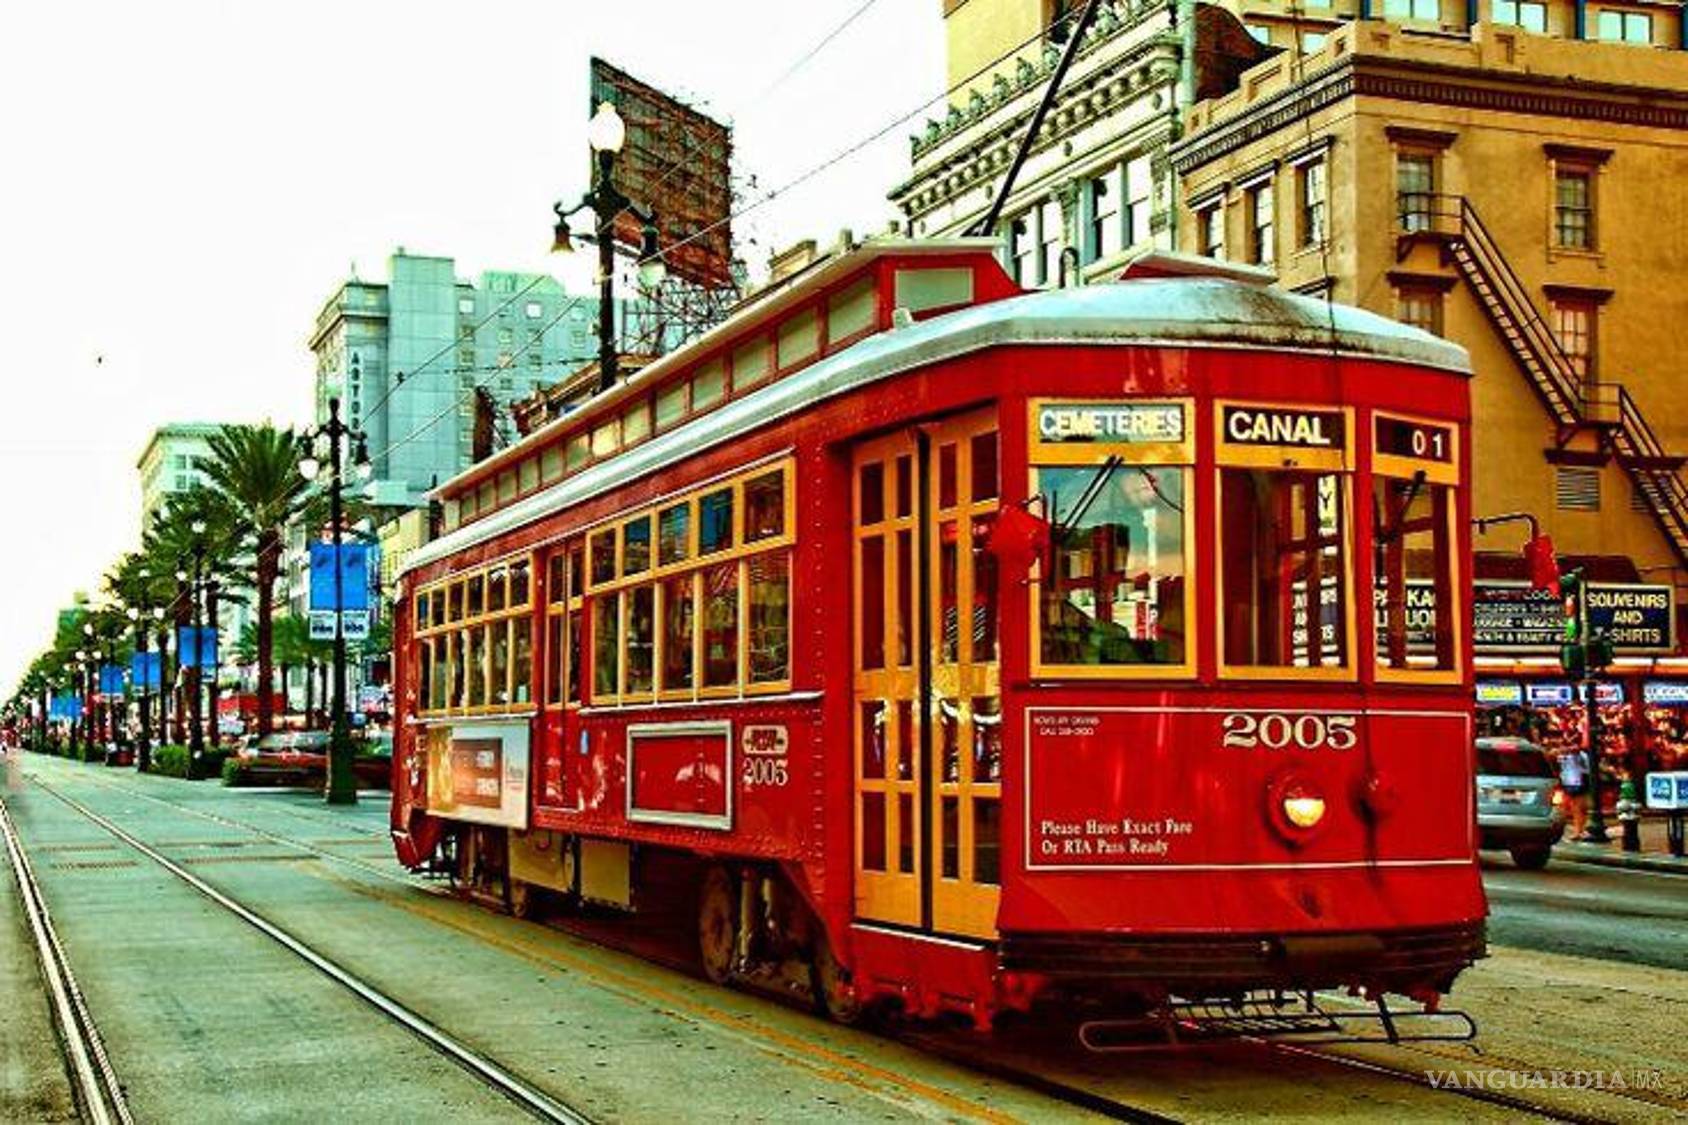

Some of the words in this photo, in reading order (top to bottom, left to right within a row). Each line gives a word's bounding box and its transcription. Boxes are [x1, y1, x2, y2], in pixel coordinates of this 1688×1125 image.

[1039, 405, 1183, 438] CEMETERIES
[1228, 411, 1331, 445] CANAL
[1587, 591, 1668, 609] SOUVENIRS
[1613, 610, 1644, 625] AND
[1222, 713, 1357, 750] 2005
[743, 757, 789, 786] 2005
[1041, 820, 1081, 836] Please
[1086, 819, 1119, 835] Have
[1123, 818, 1162, 834] Exact
[1165, 818, 1193, 834] Fare
[1042, 839, 1058, 855] Or
[1064, 838, 1092, 854] RTA
[1097, 838, 1125, 853] Pass
[1129, 838, 1169, 856] Ready
